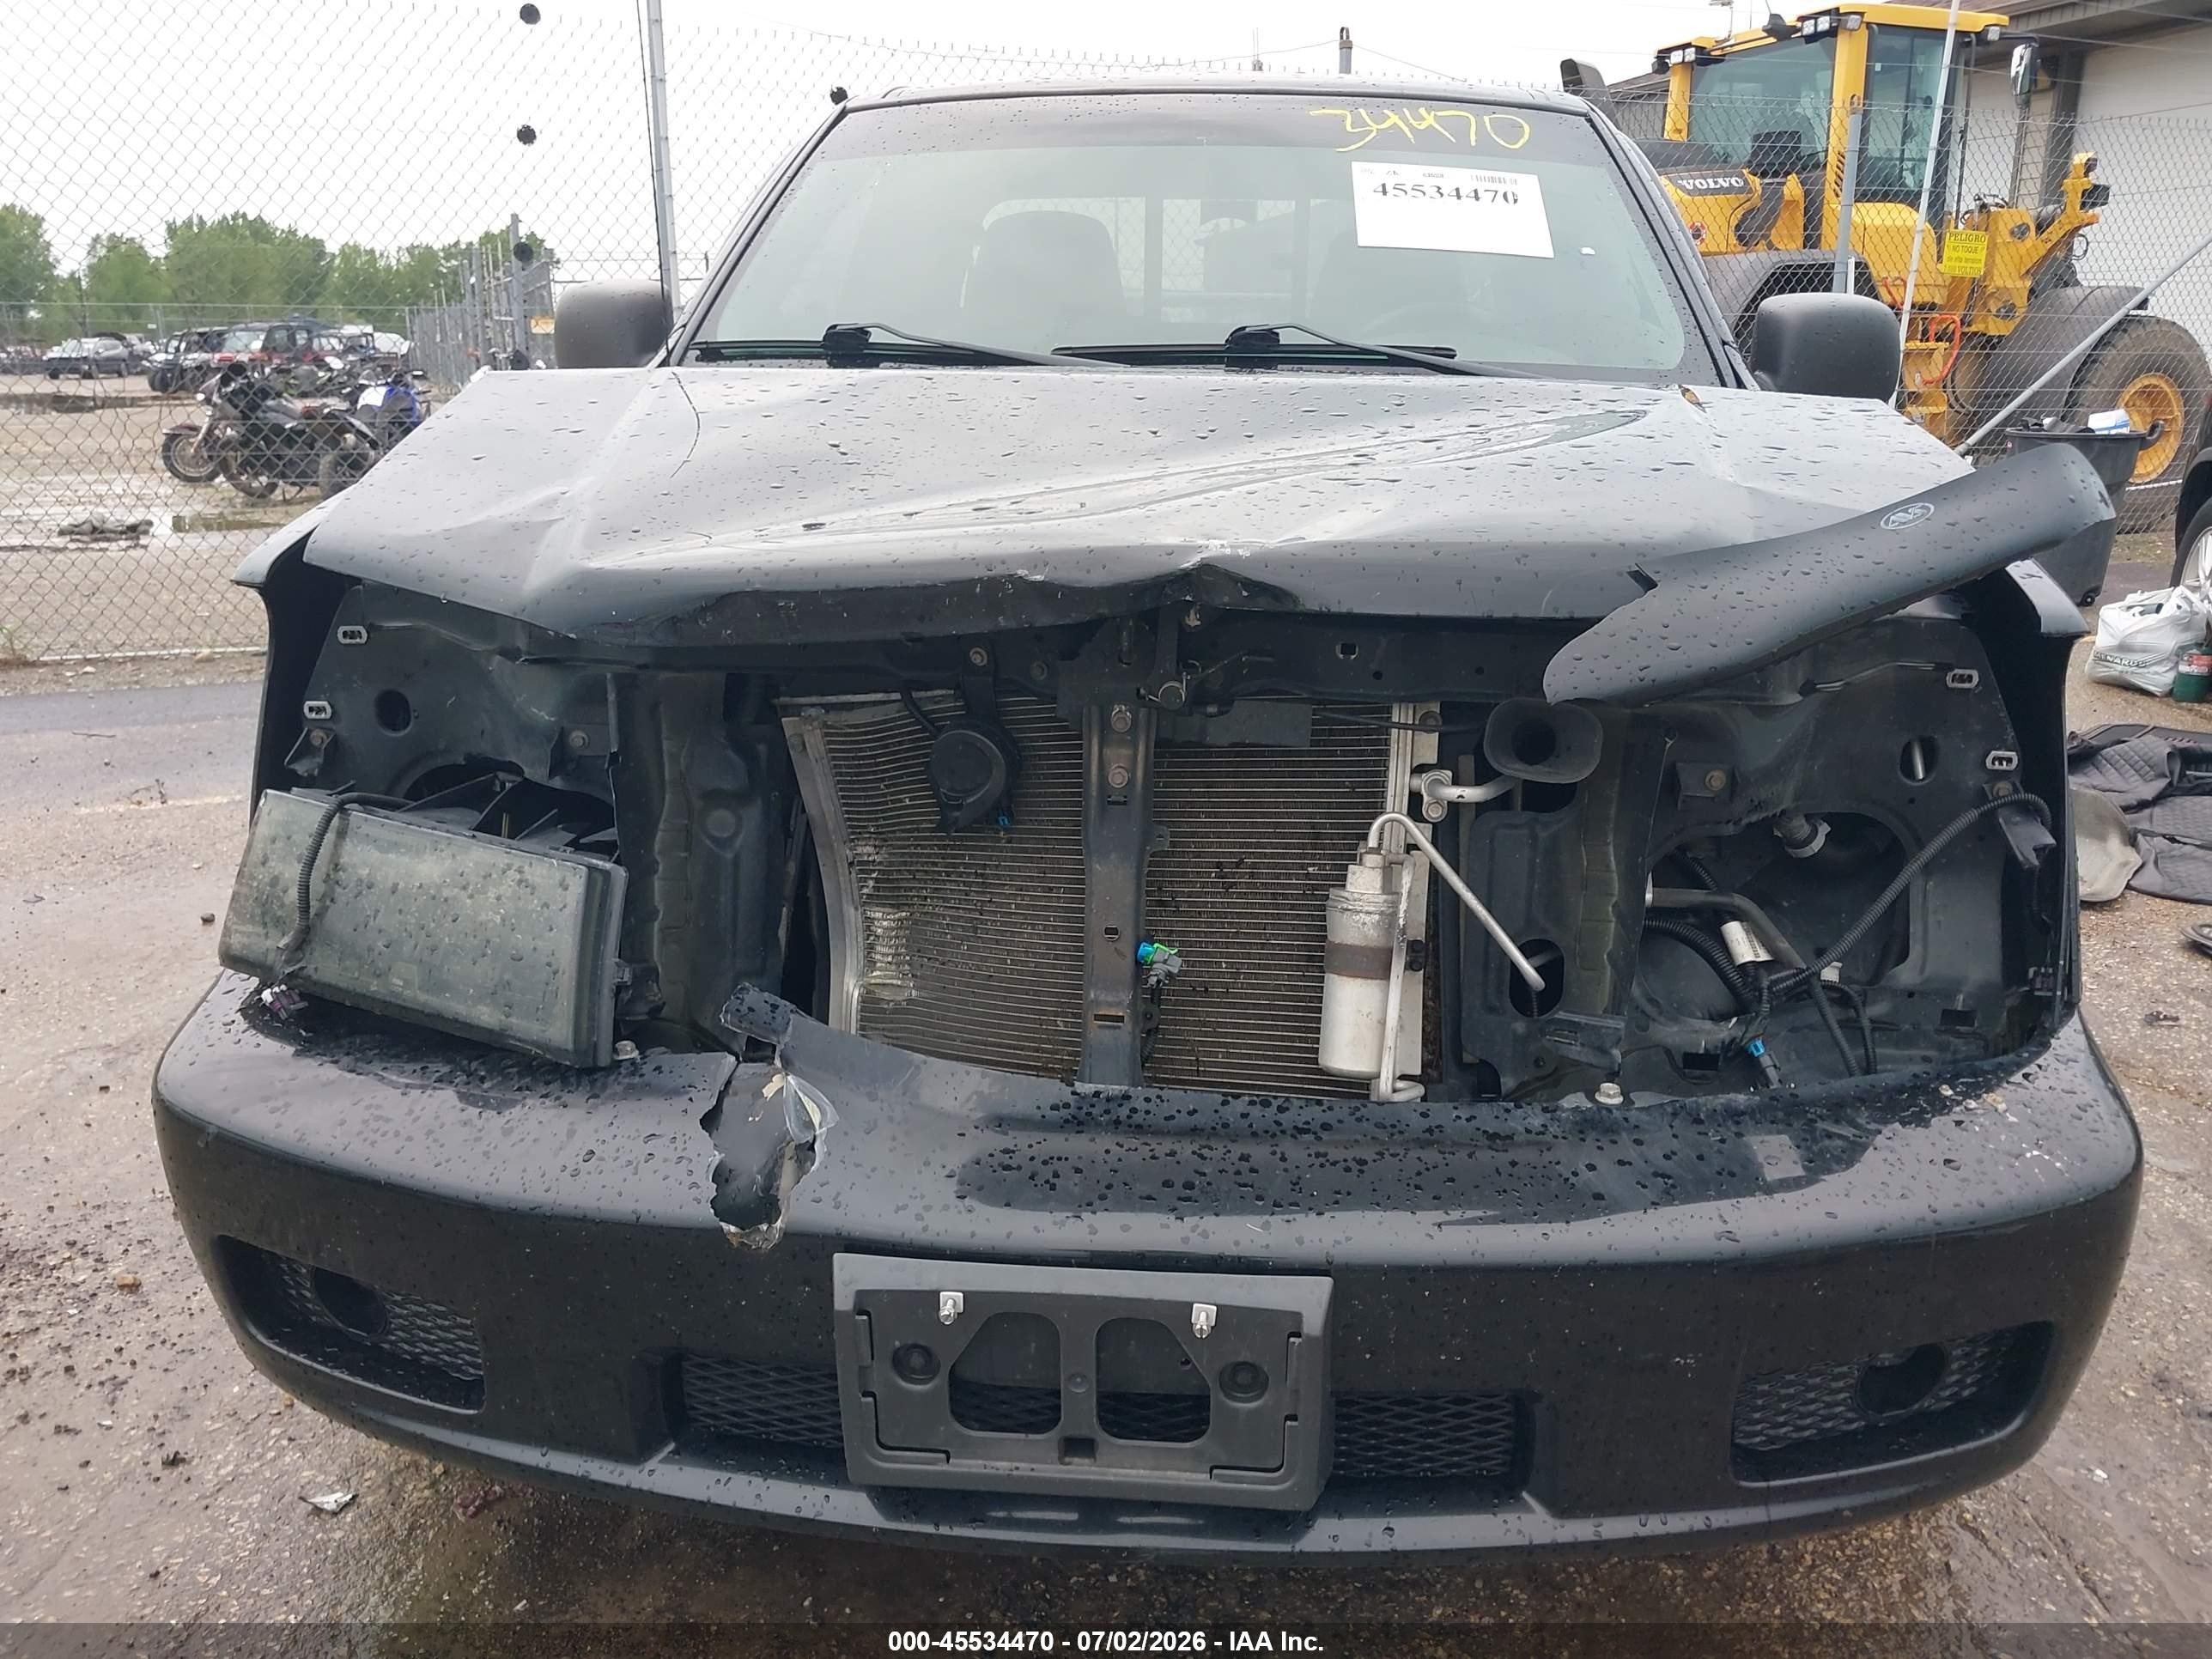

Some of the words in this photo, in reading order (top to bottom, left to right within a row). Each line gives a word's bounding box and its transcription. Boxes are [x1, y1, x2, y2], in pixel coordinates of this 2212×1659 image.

[1677, 177, 1744, 190] VOLVO
[1373, 183, 1519, 205] 45534470
[1948, 233, 1986, 243] PELIGRO
[1961, 246, 1979, 255] TOQUE
